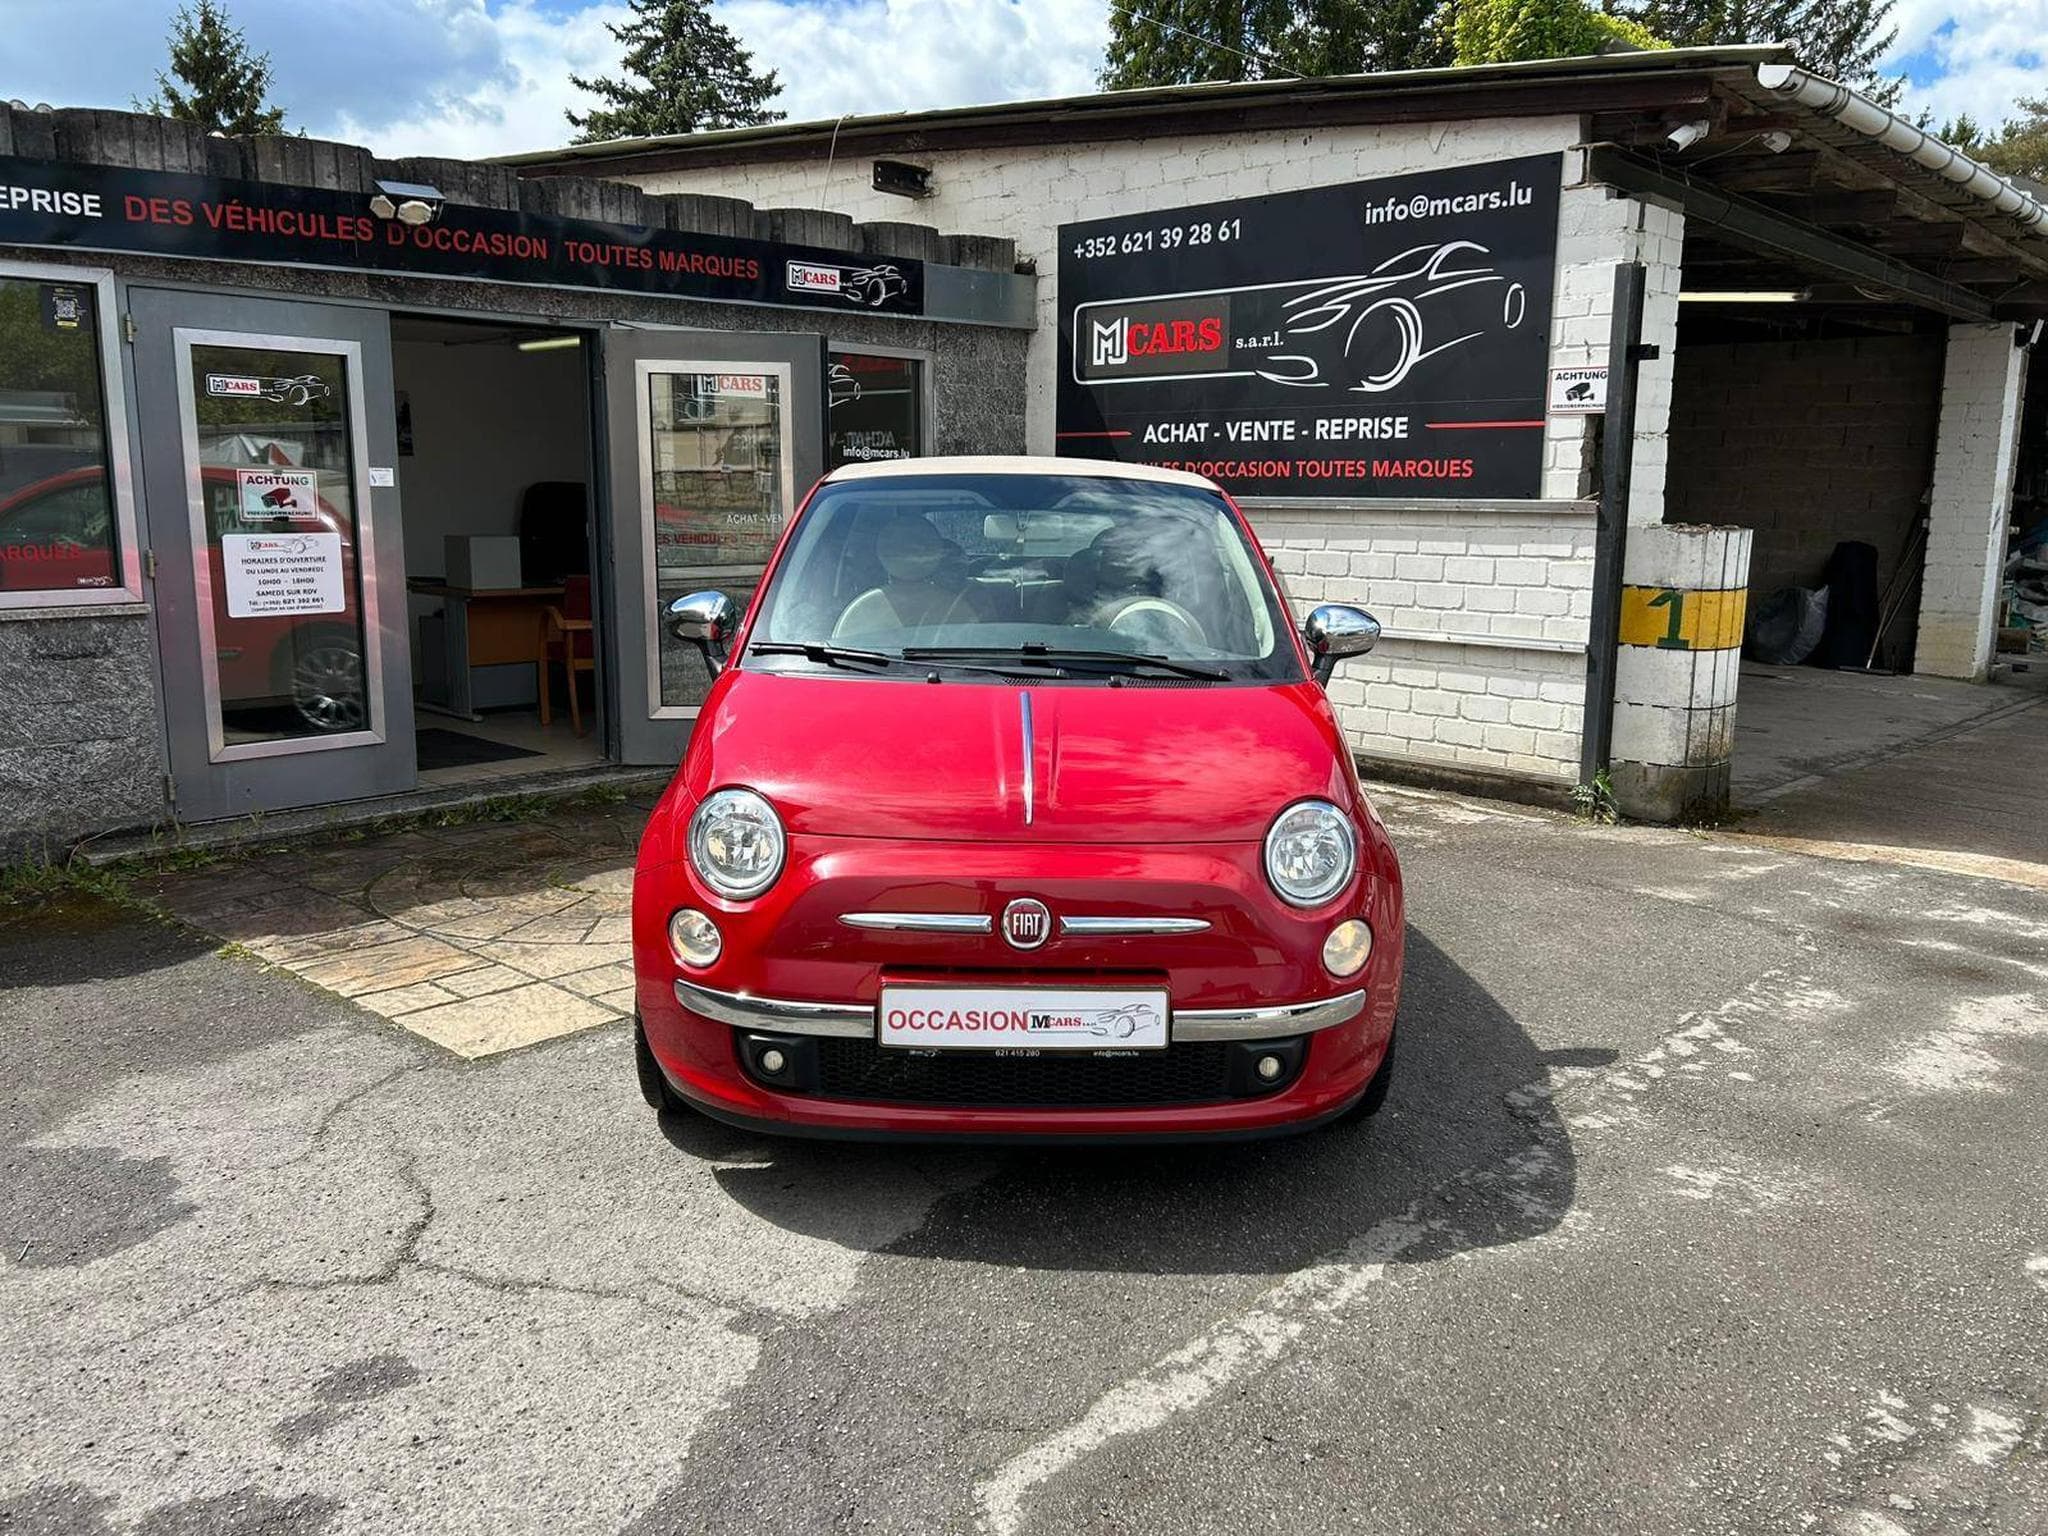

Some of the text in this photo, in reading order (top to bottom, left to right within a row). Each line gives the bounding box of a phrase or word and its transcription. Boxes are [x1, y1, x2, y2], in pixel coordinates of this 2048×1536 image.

[1364, 181, 1533, 226] info@mcars.lu
[124, 195, 195, 226] DES
[200, 200, 374, 242] VÉHICULES
[386, 223, 547, 260] D'OCCASION
[565, 240, 653, 270] TOUTES
[659, 250, 760, 280] MARQUES
[1073, 218, 1242, 260] +352 621 39 28 61
[1235, 331, 1285, 349] s.a.r.l.
[1555, 370, 1608, 381] ACHTUNG
[1142, 422, 1209, 444] ACHAT
[1225, 420, 1296, 442] VENTE
[1315, 416, 1409, 441] REPRISE
[842, 445, 910, 460] info@mcars.lu
[1185, 459, 1291, 479] D'OCCASION
[1296, 459, 1366, 479] TOUTES
[1372, 458, 1474, 479] MARQUES
[246, 475, 309, 485] ACHTUNG
[727, 513, 758, 524] ACHAT
[1647, 591, 1690, 650] 1
[1013, 913, 1041, 936] FIAT
[888, 1010, 1028, 1032] OCCASION
